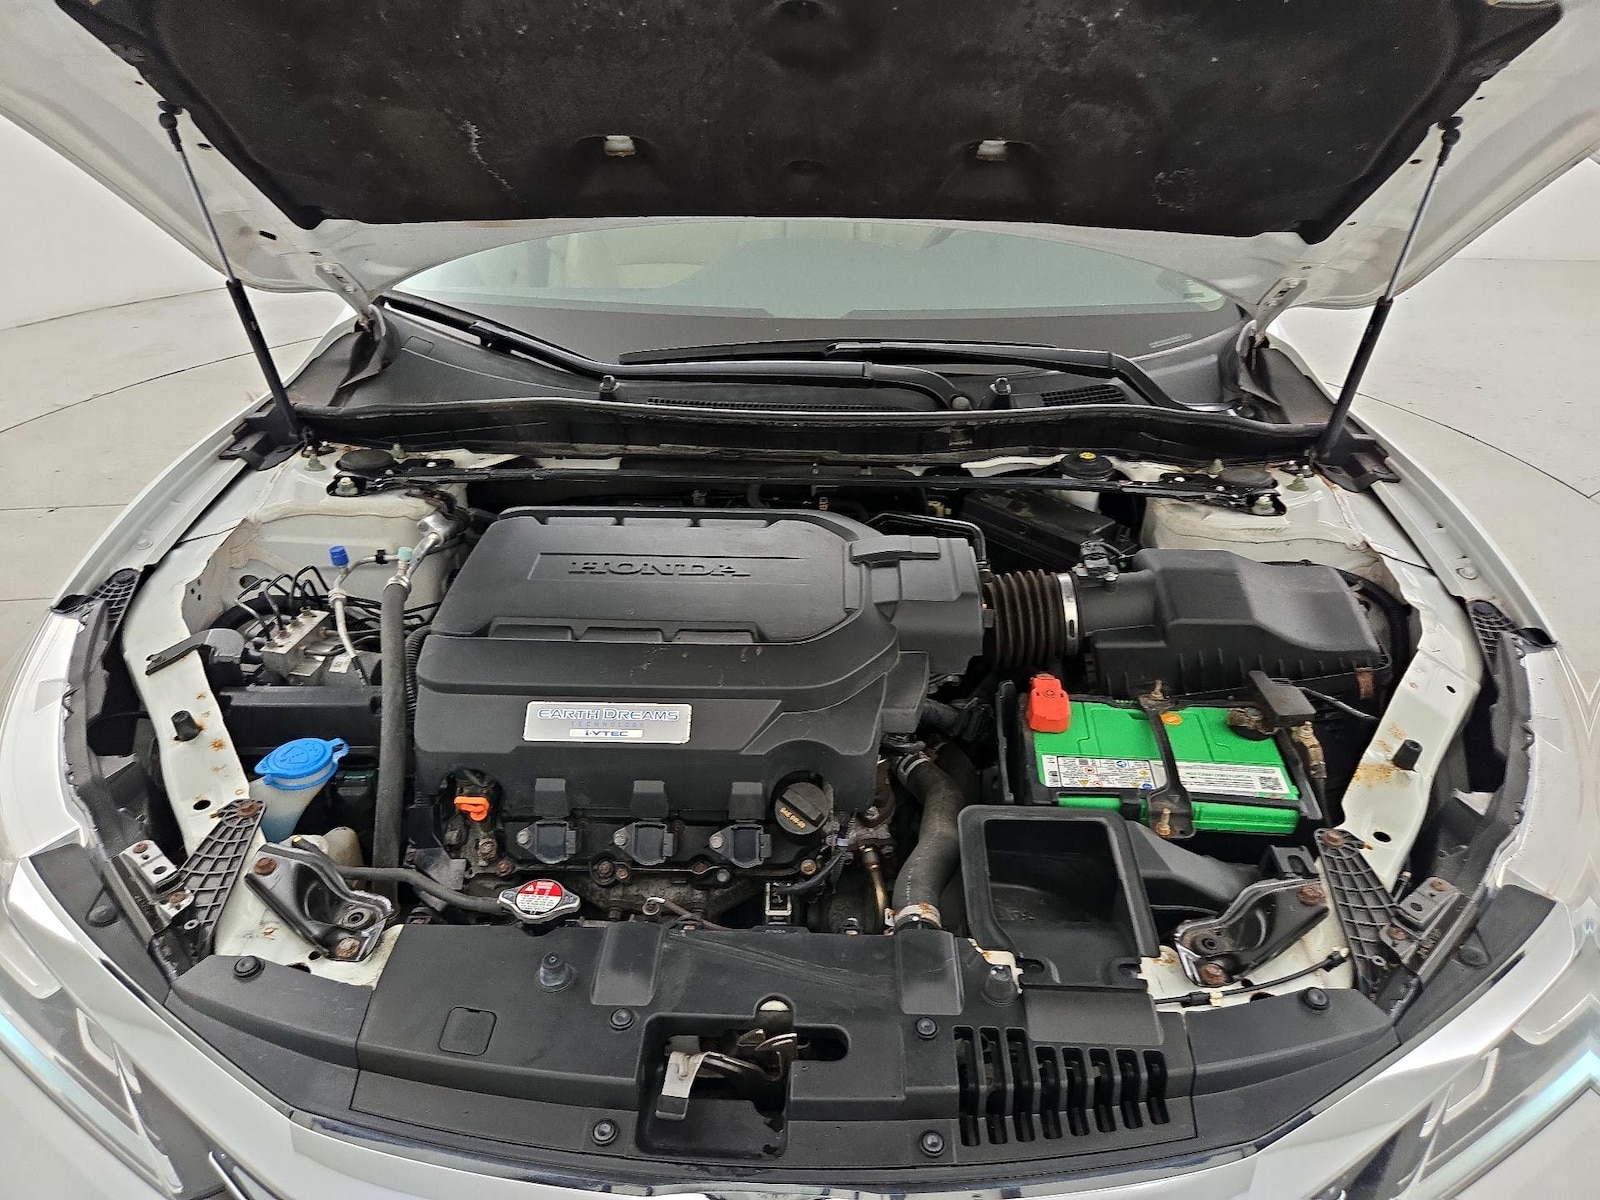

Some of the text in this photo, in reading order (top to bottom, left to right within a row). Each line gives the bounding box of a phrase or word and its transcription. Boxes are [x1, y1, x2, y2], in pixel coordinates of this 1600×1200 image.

[568, 562, 750, 577] HONDA
[538, 708, 680, 721] EARTH DREAMS
